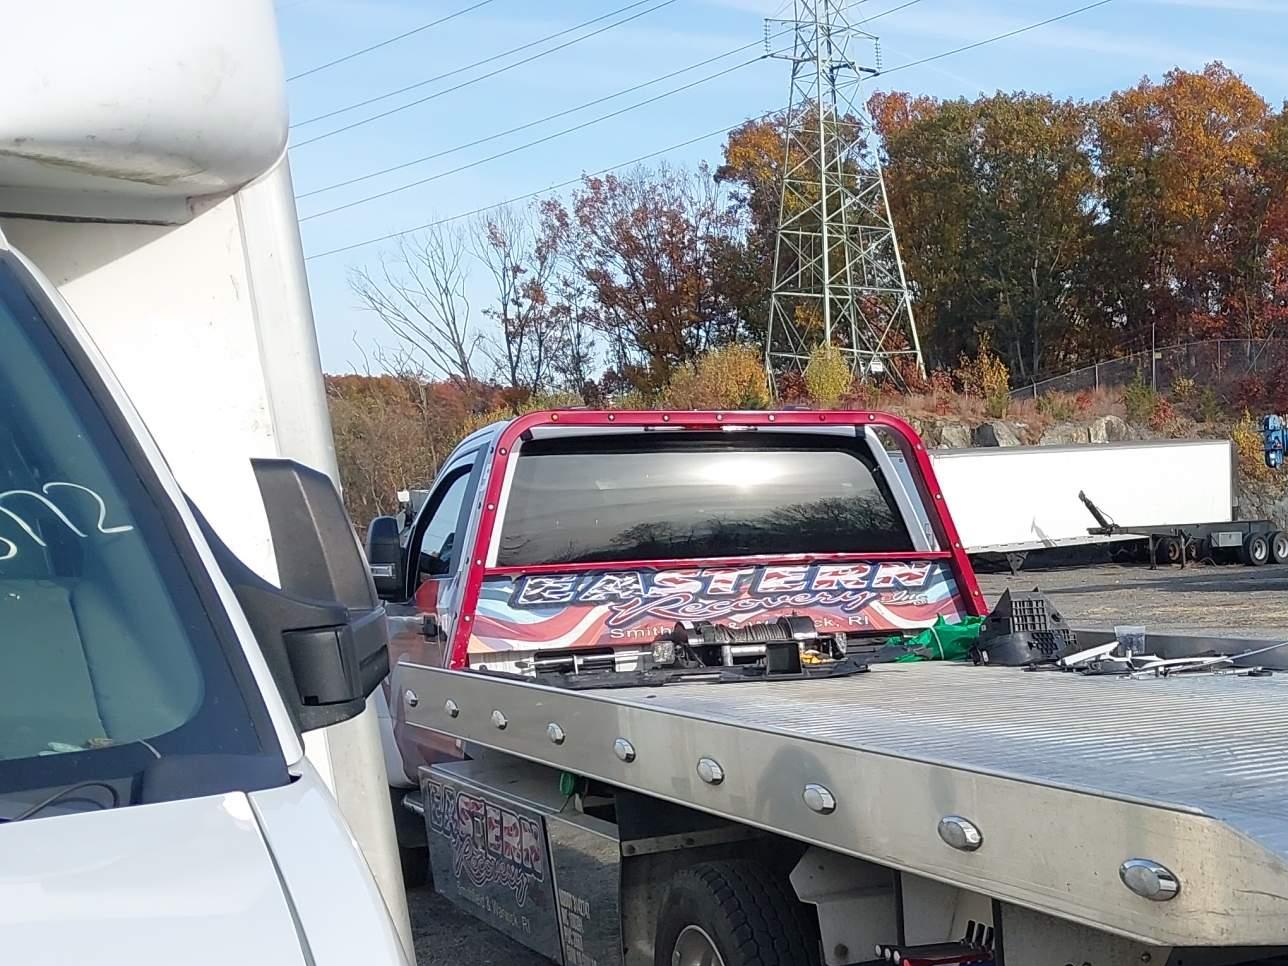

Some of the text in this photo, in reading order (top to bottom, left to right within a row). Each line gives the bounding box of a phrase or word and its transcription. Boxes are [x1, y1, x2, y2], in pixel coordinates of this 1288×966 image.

[516, 561, 932, 605] EASTERN
[609, 590, 878, 626] Recovery
[848, 615, 869, 626] RI
[429, 782, 543, 878] EASTERN
